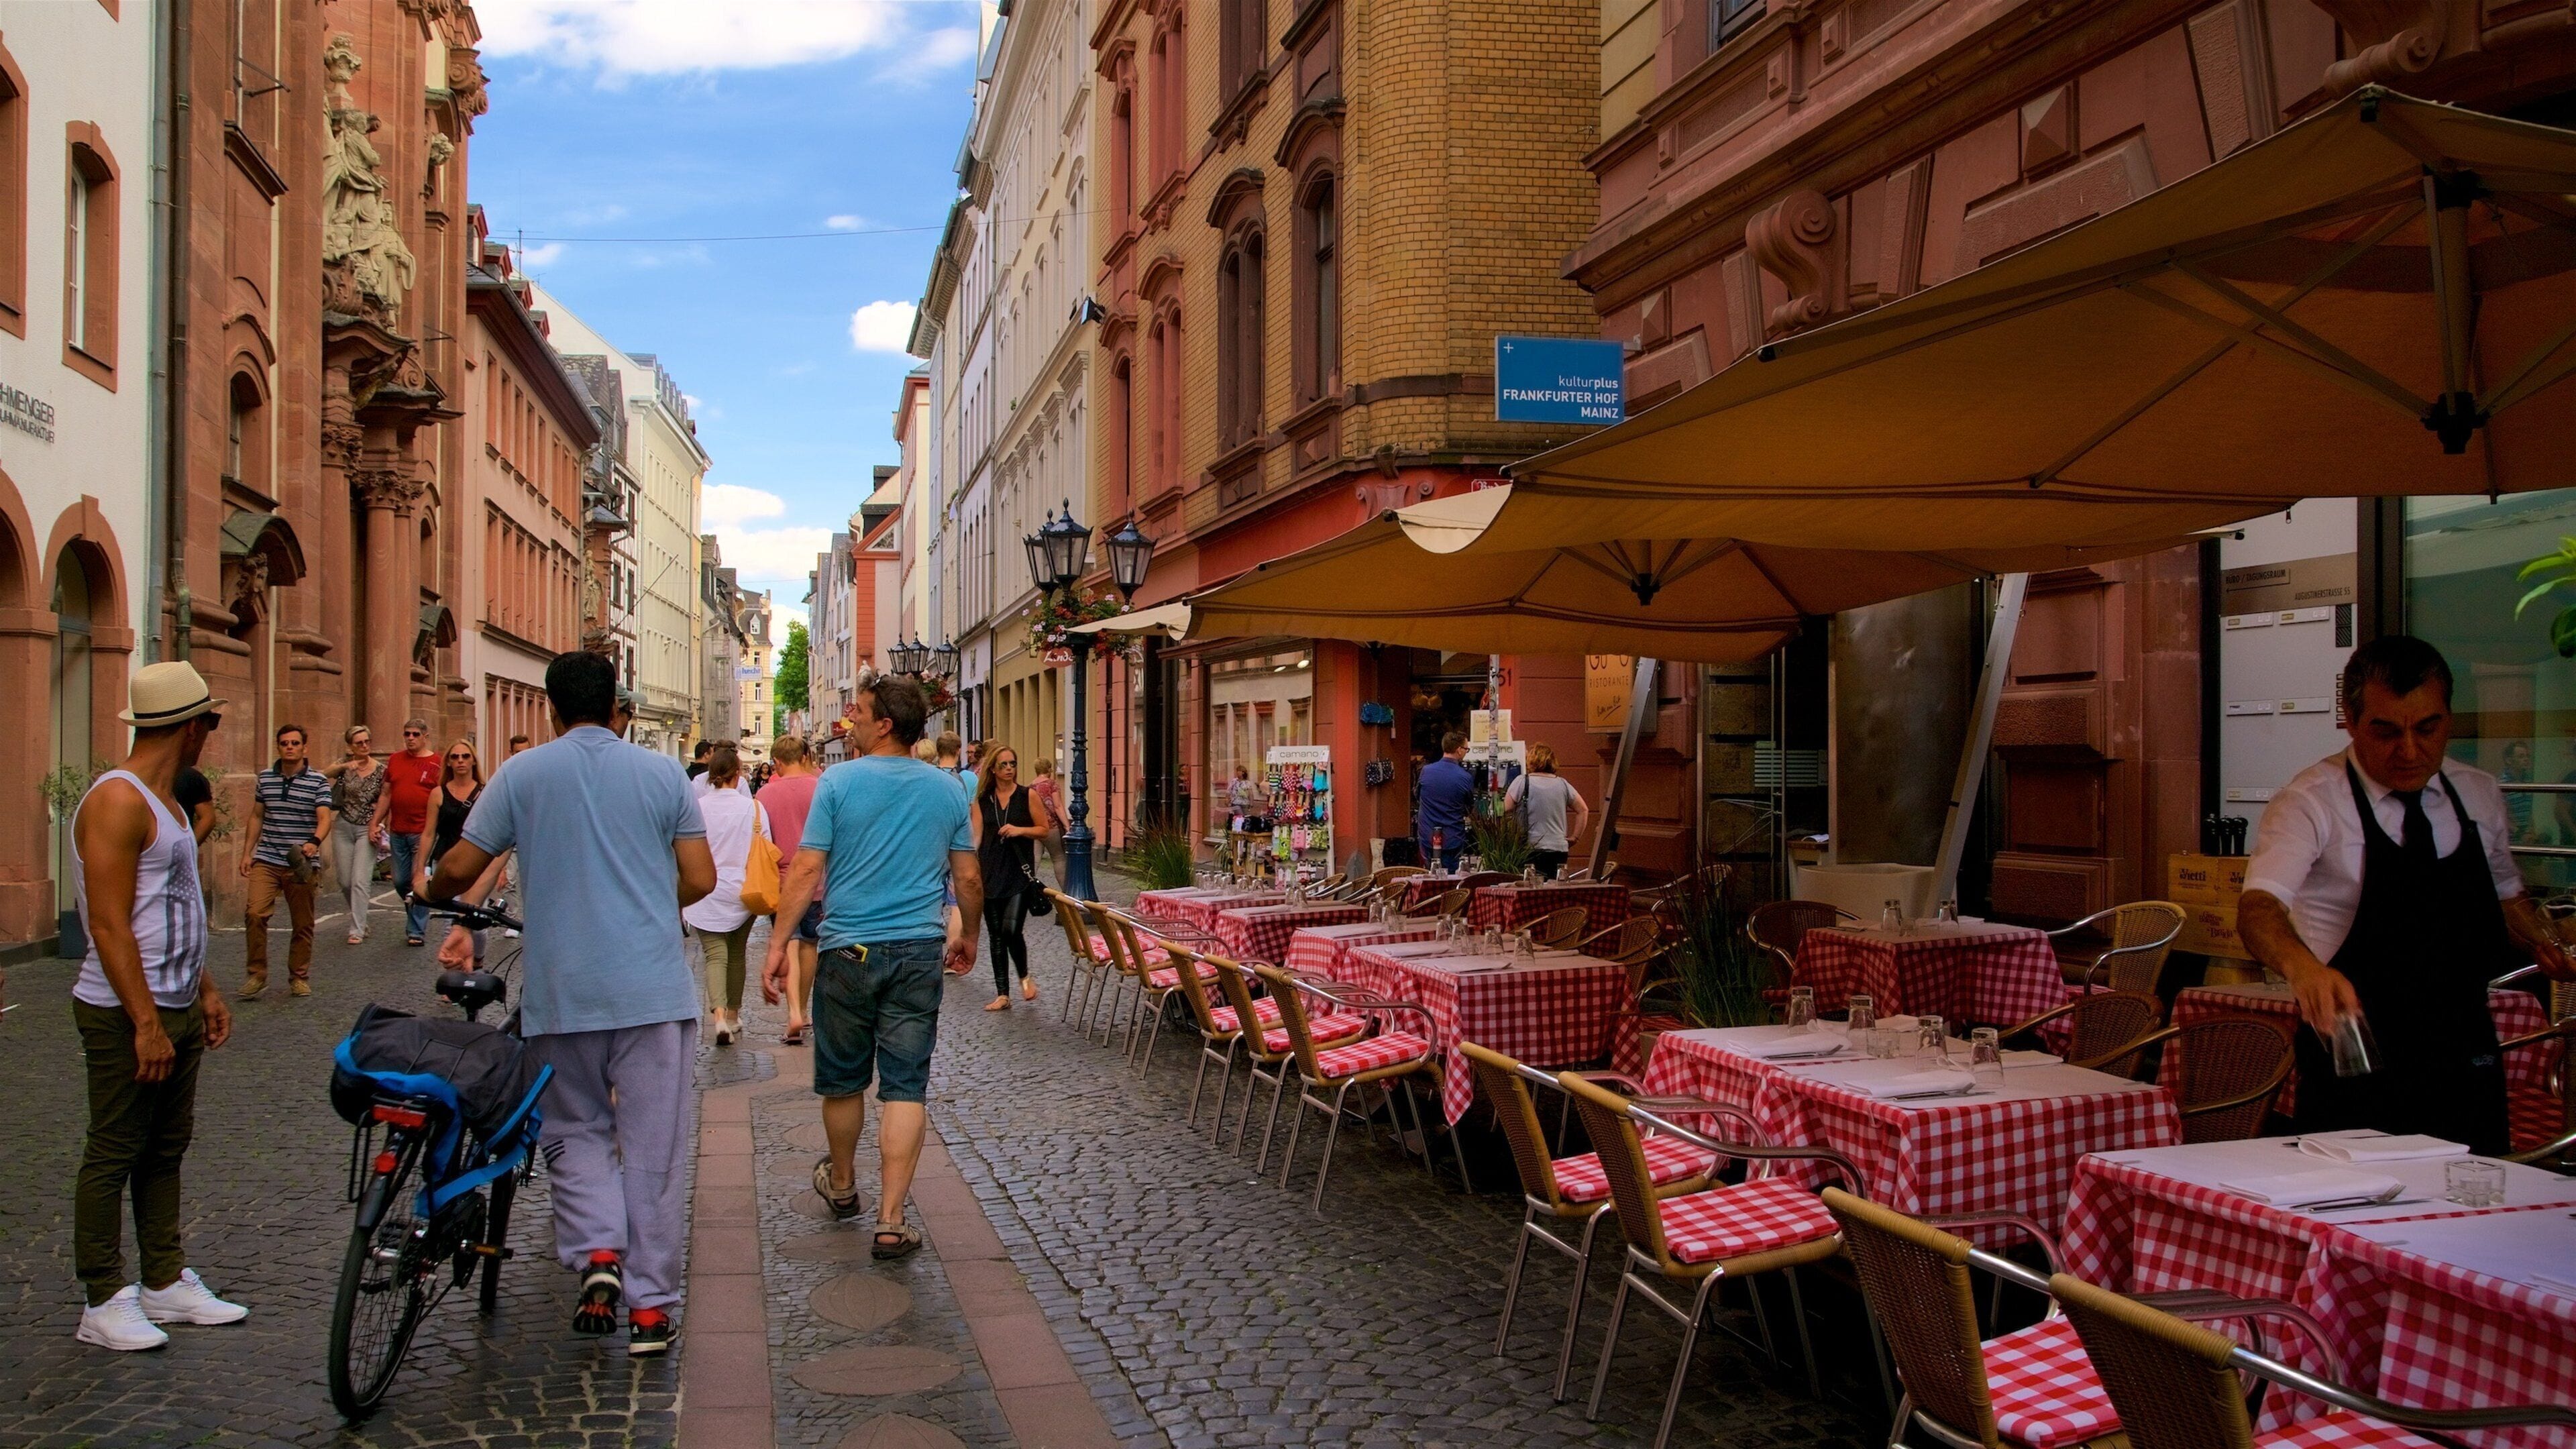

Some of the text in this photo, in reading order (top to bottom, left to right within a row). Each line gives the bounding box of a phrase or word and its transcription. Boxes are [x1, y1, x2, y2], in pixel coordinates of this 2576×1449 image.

[1558, 375, 1619, 390] kulturplus
[1503, 388, 1619, 404] FRANKFURTER HOF
[0, 382, 54, 427] HMENGER
[1581, 407, 1619, 419] MAINZ
[2246, 569, 2287, 582] TAGUNGSRAUM
[2295, 586, 2351, 600] AUGUSTINERSTRASSE 55
[1499, 668, 1512, 686] 51
[1589, 675, 1629, 688] RISTORANTE
